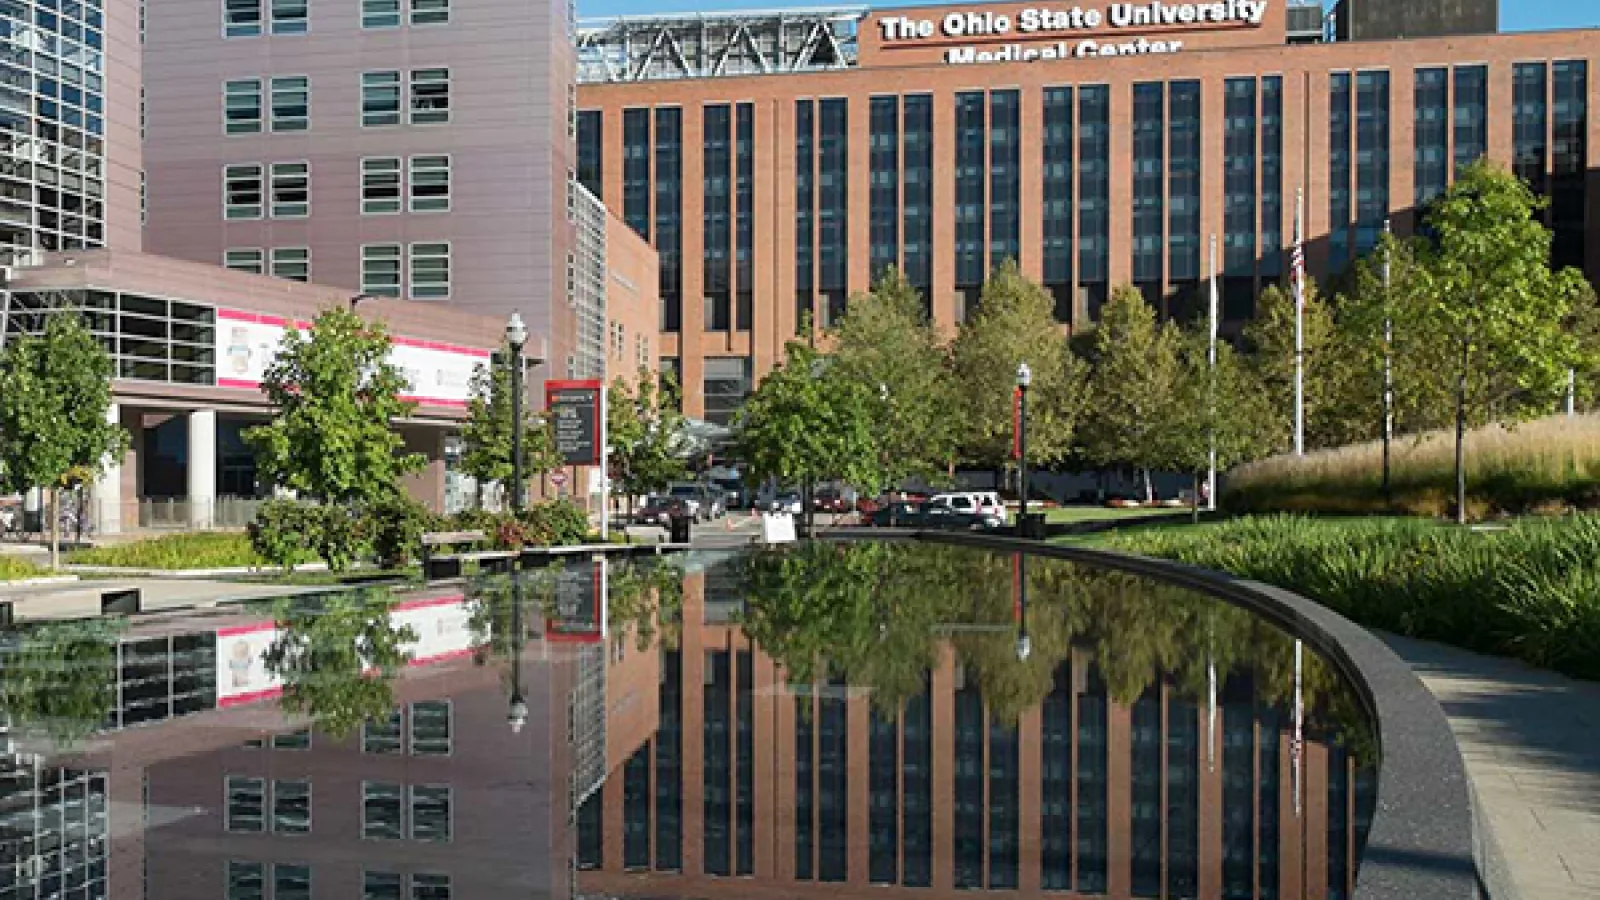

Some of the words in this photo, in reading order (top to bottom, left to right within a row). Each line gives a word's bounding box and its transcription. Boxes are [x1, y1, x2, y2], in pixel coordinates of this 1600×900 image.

[879, 16, 934, 39] The
[942, 11, 1011, 35] Ohio
[1018, 6, 1102, 31] State
[1109, 0, 1267, 27] University
[947, 42, 1067, 64] Medical
[1075, 38, 1183, 58] Center
